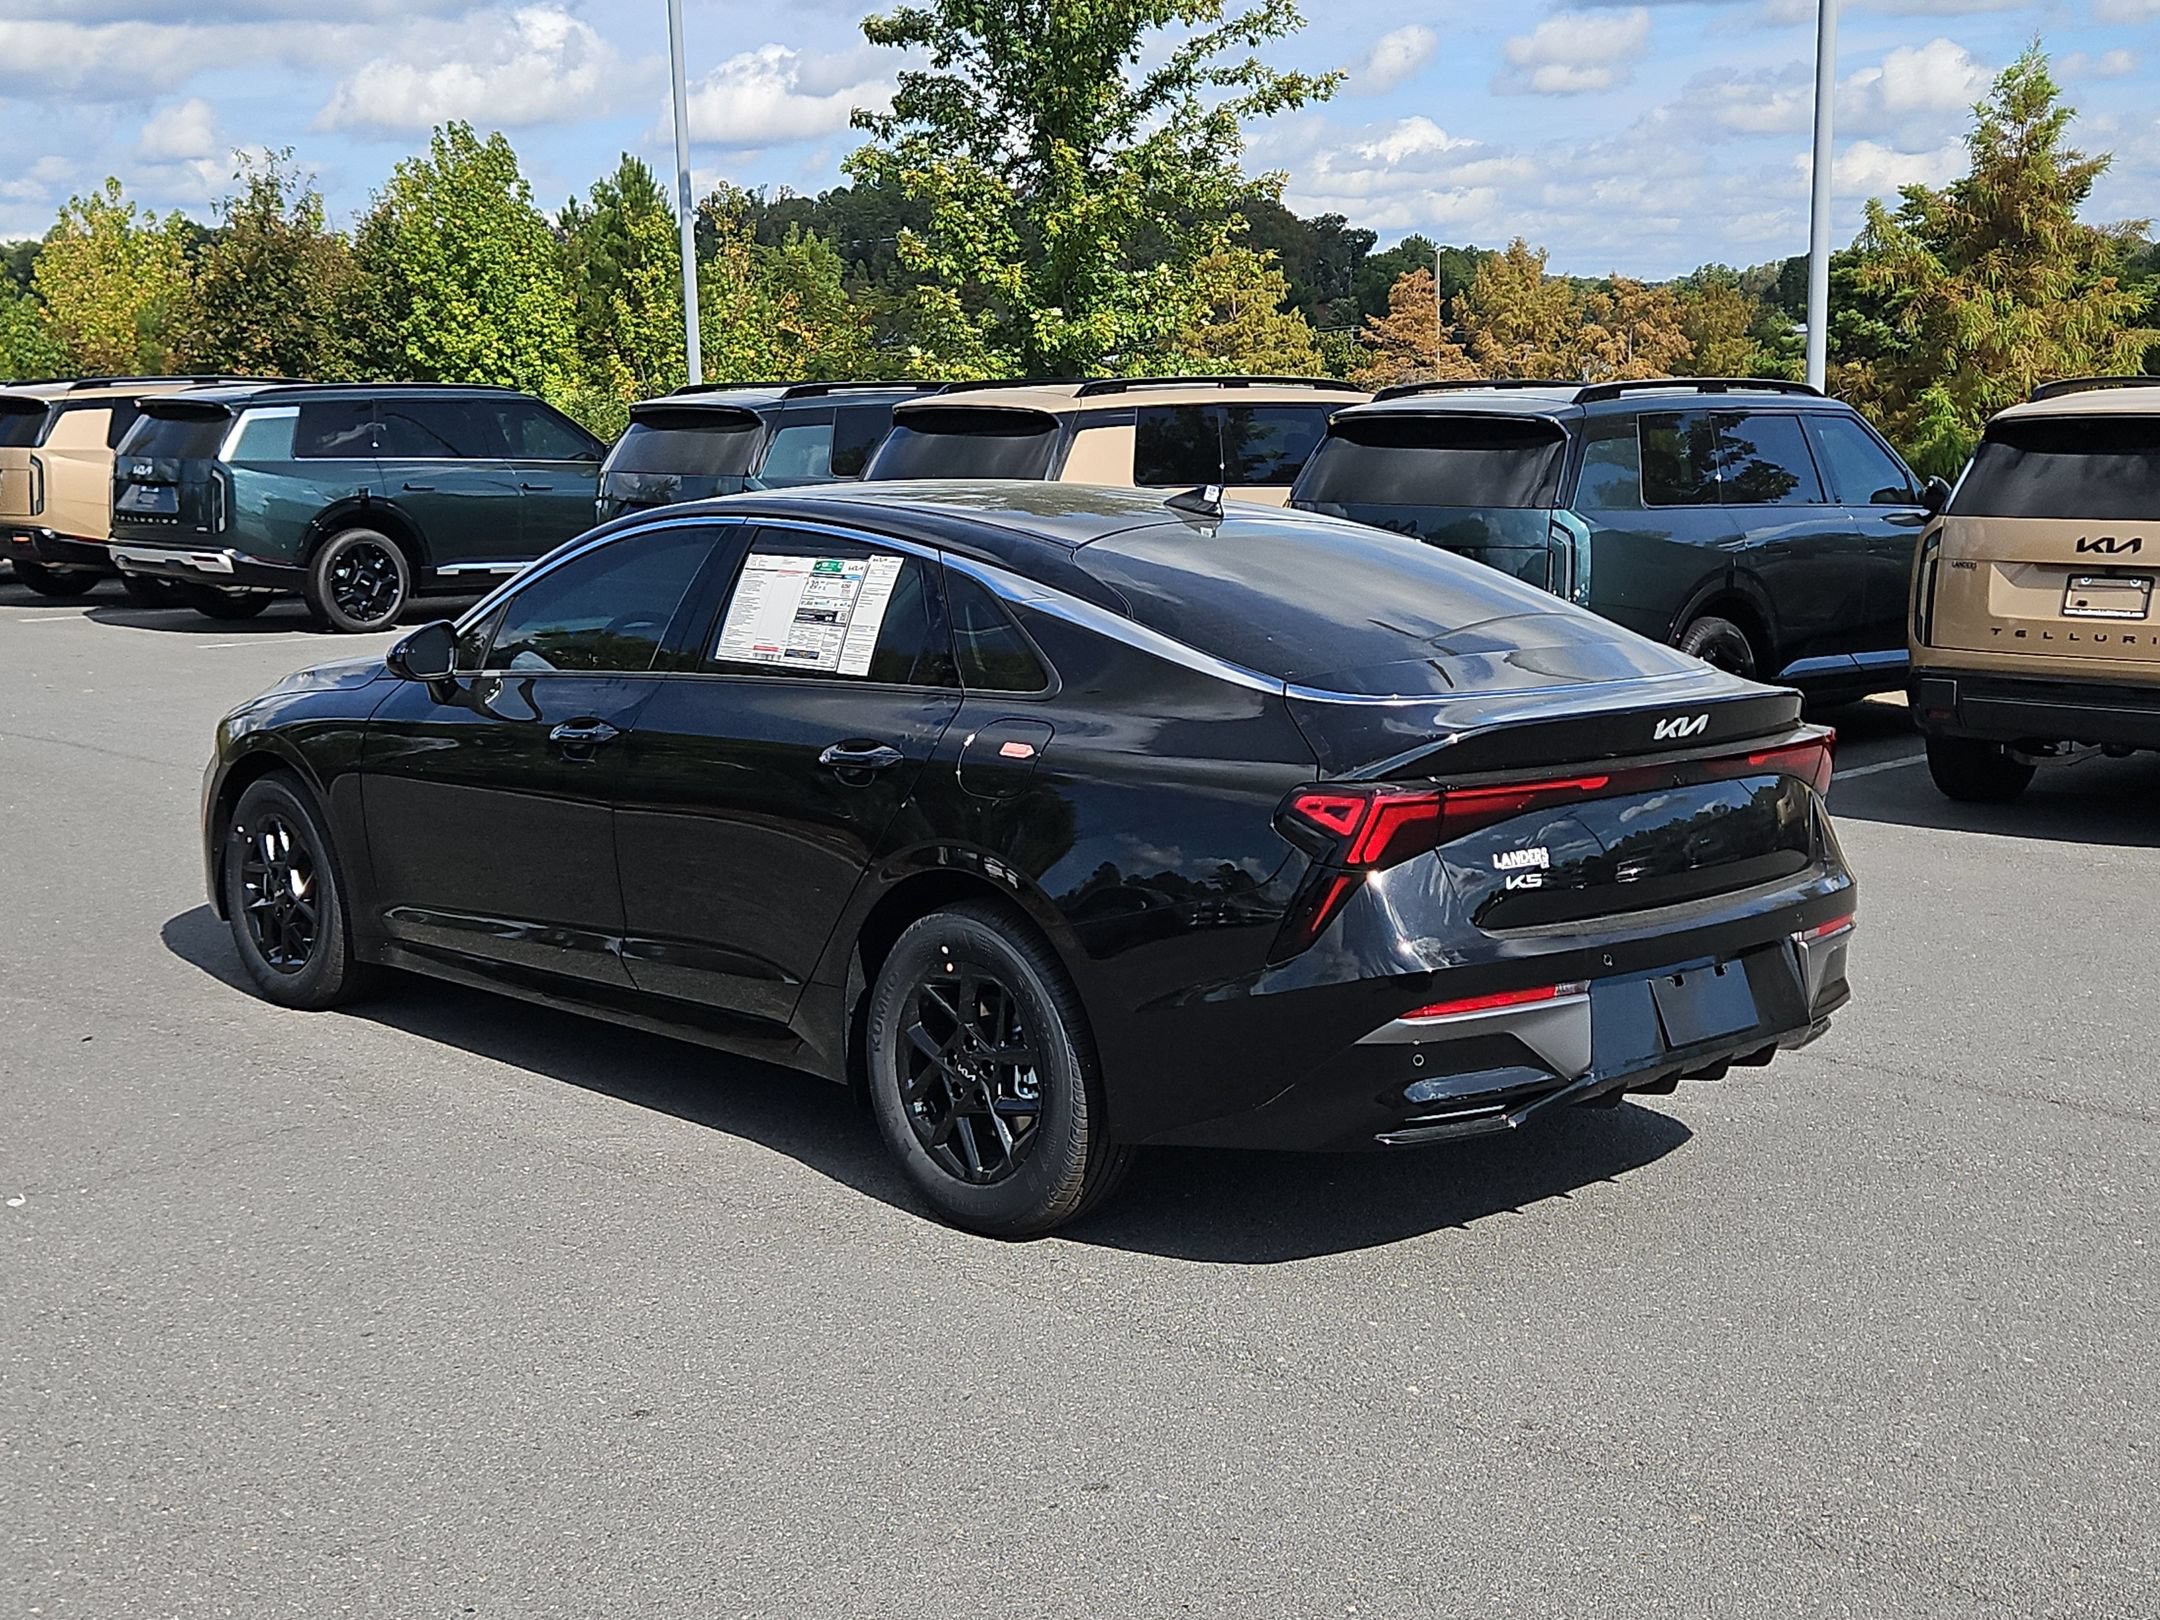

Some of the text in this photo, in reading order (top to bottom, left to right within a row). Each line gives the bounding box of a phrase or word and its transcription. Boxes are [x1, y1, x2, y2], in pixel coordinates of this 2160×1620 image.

[2075, 536, 2143, 554] KIA
[1652, 714, 1709, 740] KIA
[1492, 846, 1550, 870] LANDERS
[1505, 873, 1543, 891] K5
